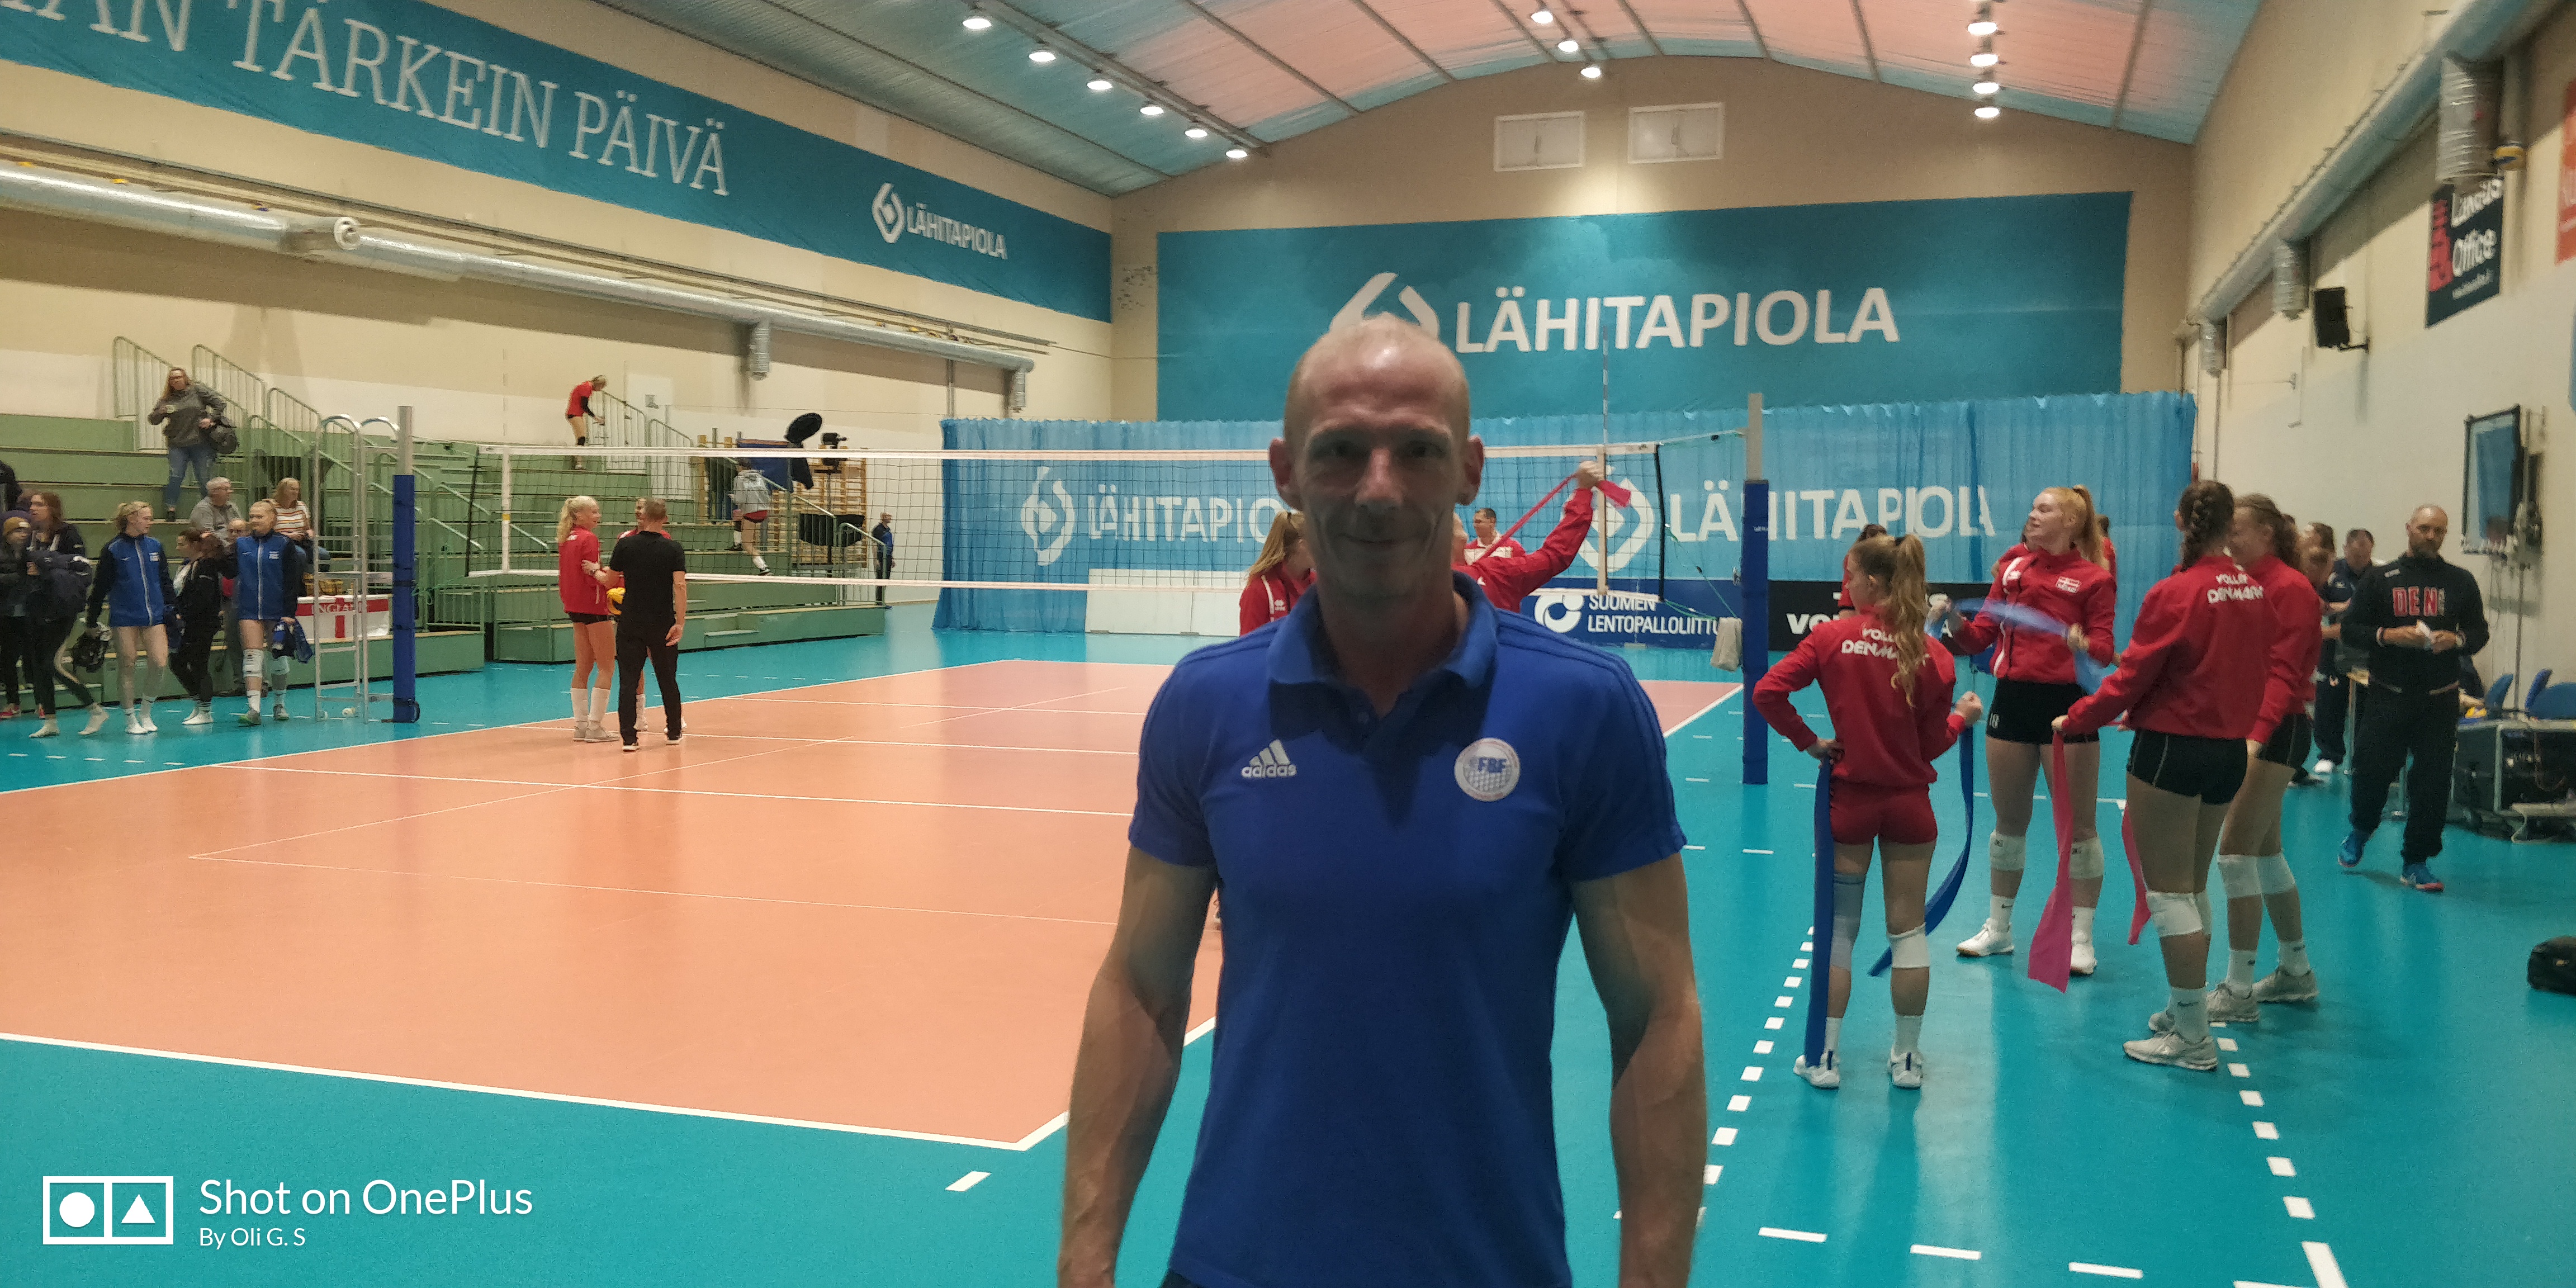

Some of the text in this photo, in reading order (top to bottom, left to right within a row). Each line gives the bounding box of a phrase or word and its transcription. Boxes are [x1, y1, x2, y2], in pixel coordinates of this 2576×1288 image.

[568, 89, 730, 196] PÄIVÄ
[906, 202, 1008, 260] LÄHITAPIOLA
[1456, 286, 1900, 353] LÄHITAPIOLA
[1087, 484, 1286, 544] LÄHITAPIO
[1589, 594, 1656, 612] SUOMEN
[1863, 628, 1895, 643] VOLL
[1241, 764, 1298, 779] adidas
